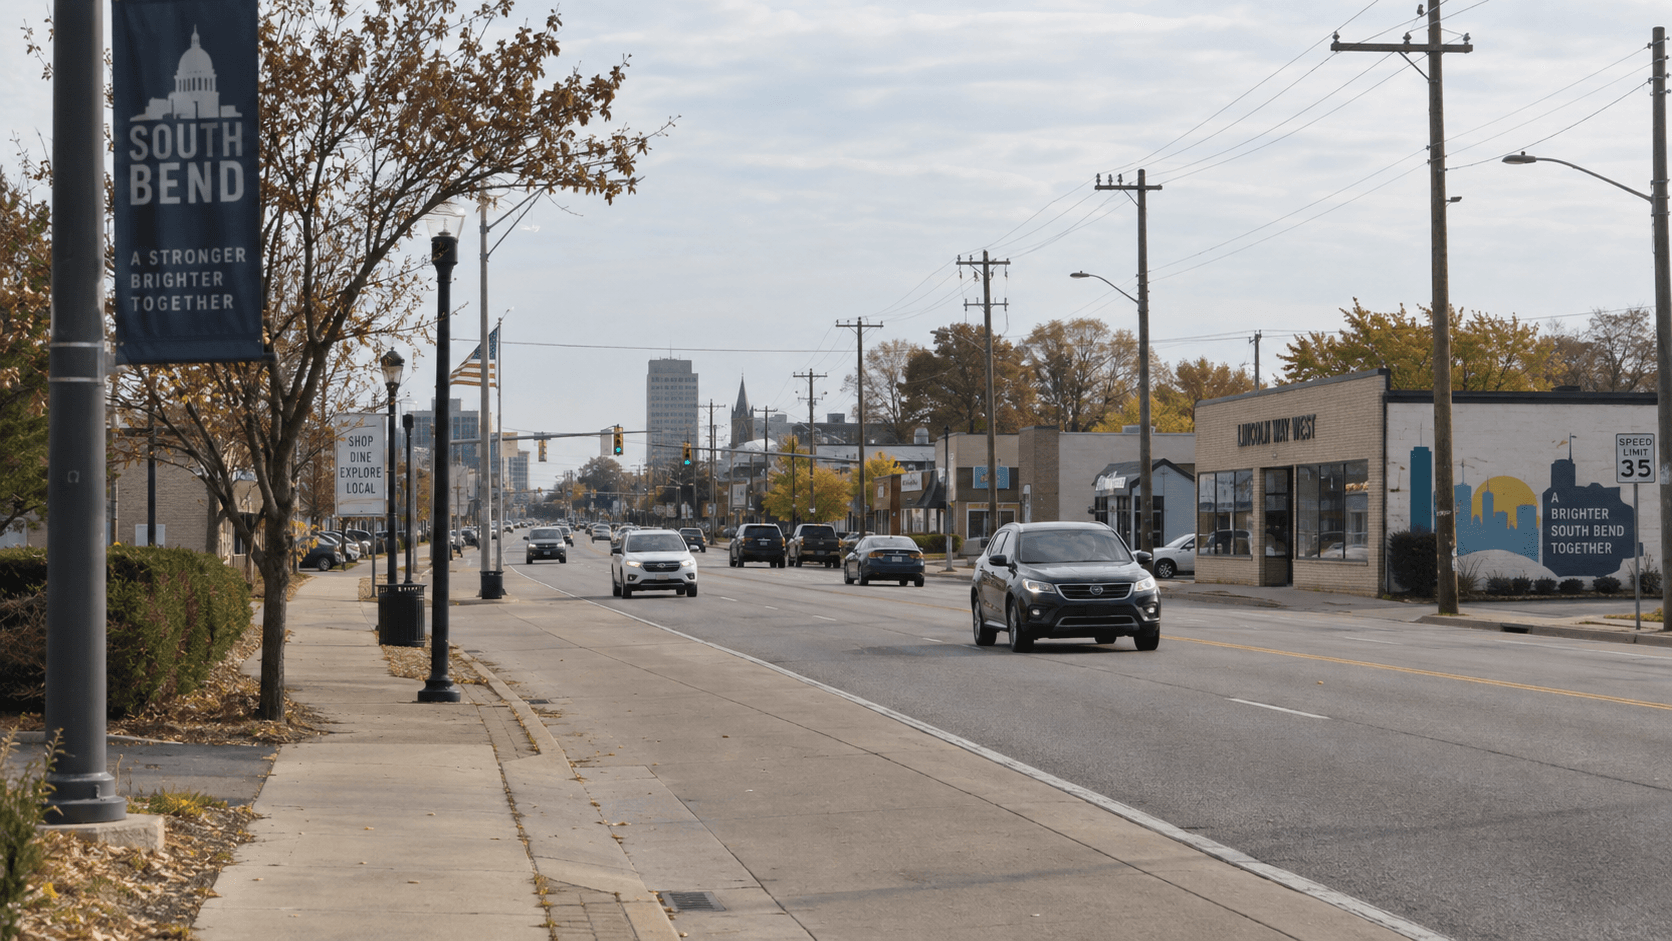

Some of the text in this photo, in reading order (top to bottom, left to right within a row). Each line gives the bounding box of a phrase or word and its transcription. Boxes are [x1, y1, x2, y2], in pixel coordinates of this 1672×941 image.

[129, 122, 242, 161] SOUTH
[130, 161, 244, 205] BEND
[131, 247, 246, 266] A STRONGER
[131, 271, 223, 288] BRIGHTER
[131, 294, 233, 311] TOGETHER
[1272, 418, 1290, 443] WAY
[1292, 414, 1316, 441] WEST
[348, 435, 373, 447] SHOP
[1619, 438, 1652, 446] SPEED
[350, 451, 372, 463] DINE
[1623, 448, 1648, 456] LIMIT
[340, 466, 381, 478] EXPLORE
[1621, 459, 1651, 478] 35
[346, 482, 376, 494] LOCAL
[1551, 492, 1559, 503] A
[1551, 508, 1609, 520] BRIGHTER
[1551, 525, 1625, 537] SOUTH BEND
[1551, 542, 1612, 554] TOGETHER
